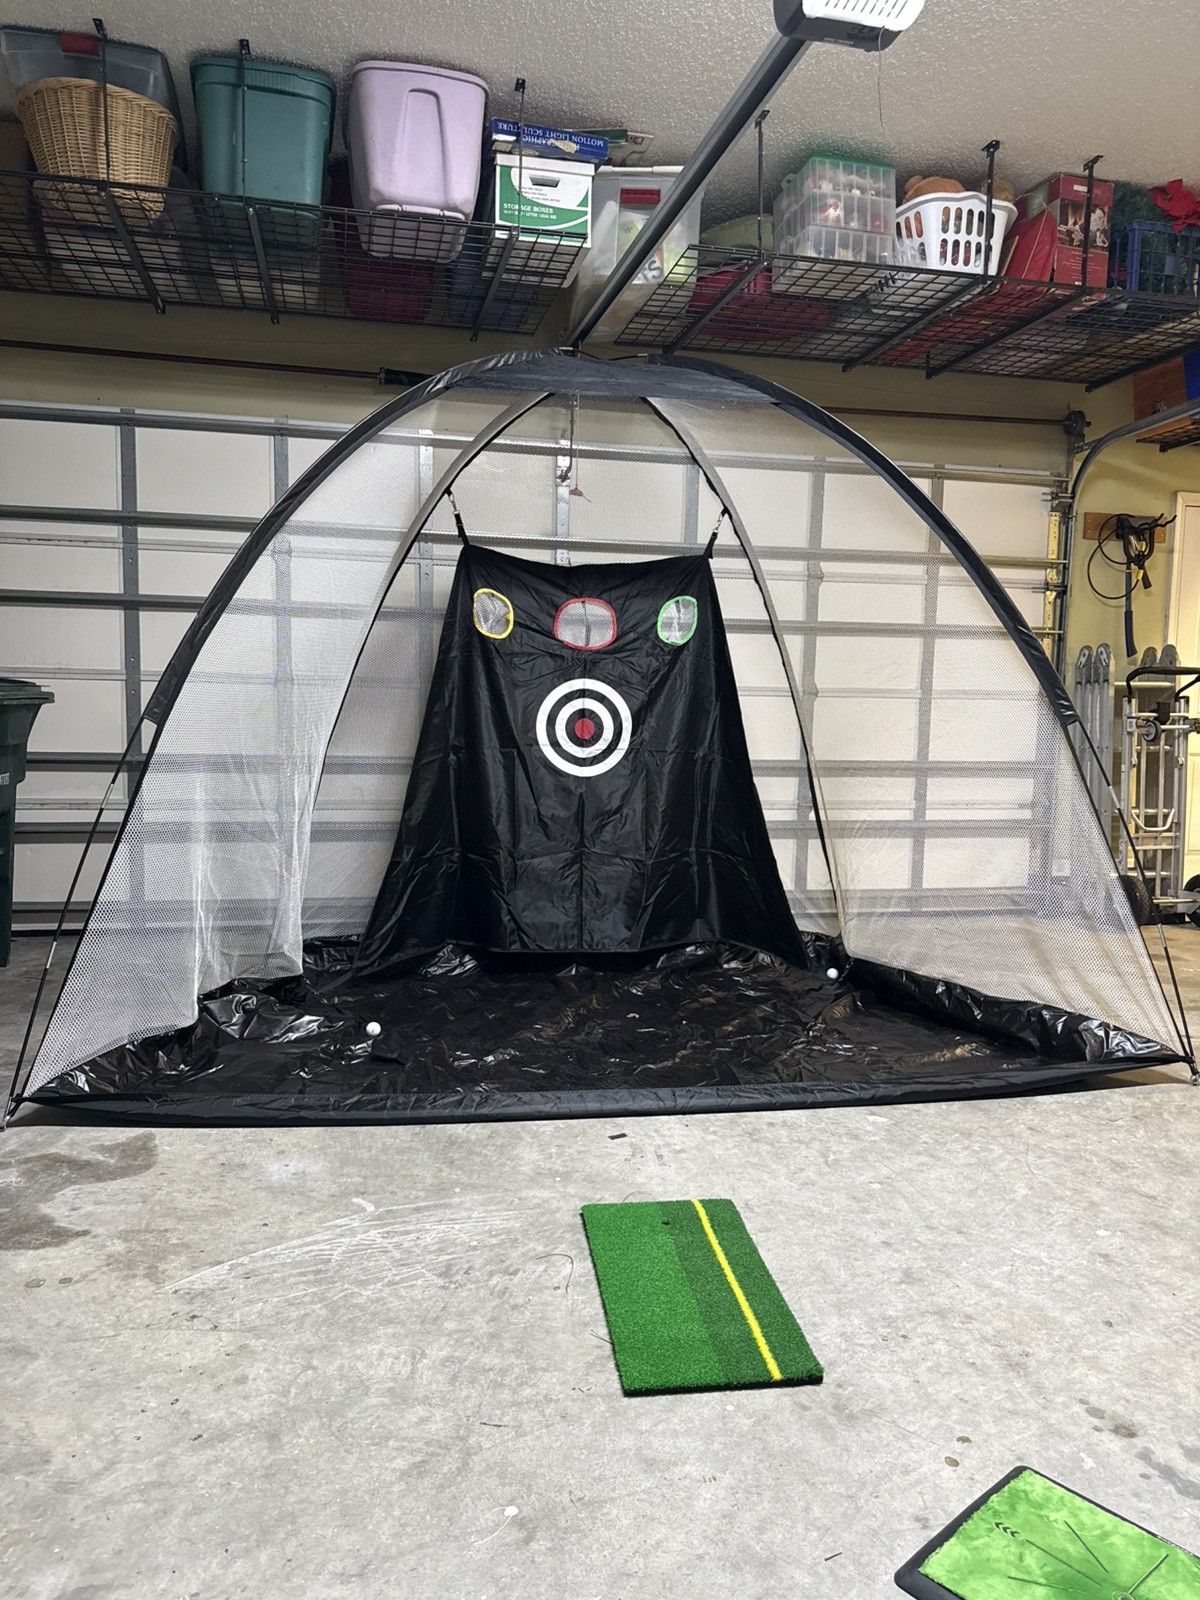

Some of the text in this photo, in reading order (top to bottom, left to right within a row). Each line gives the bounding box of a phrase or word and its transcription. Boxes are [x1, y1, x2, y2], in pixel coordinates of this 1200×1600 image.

[497, 122, 604, 147] MOTION LIGHT SCULTURE
[533, 206, 554, 214] BOXES
